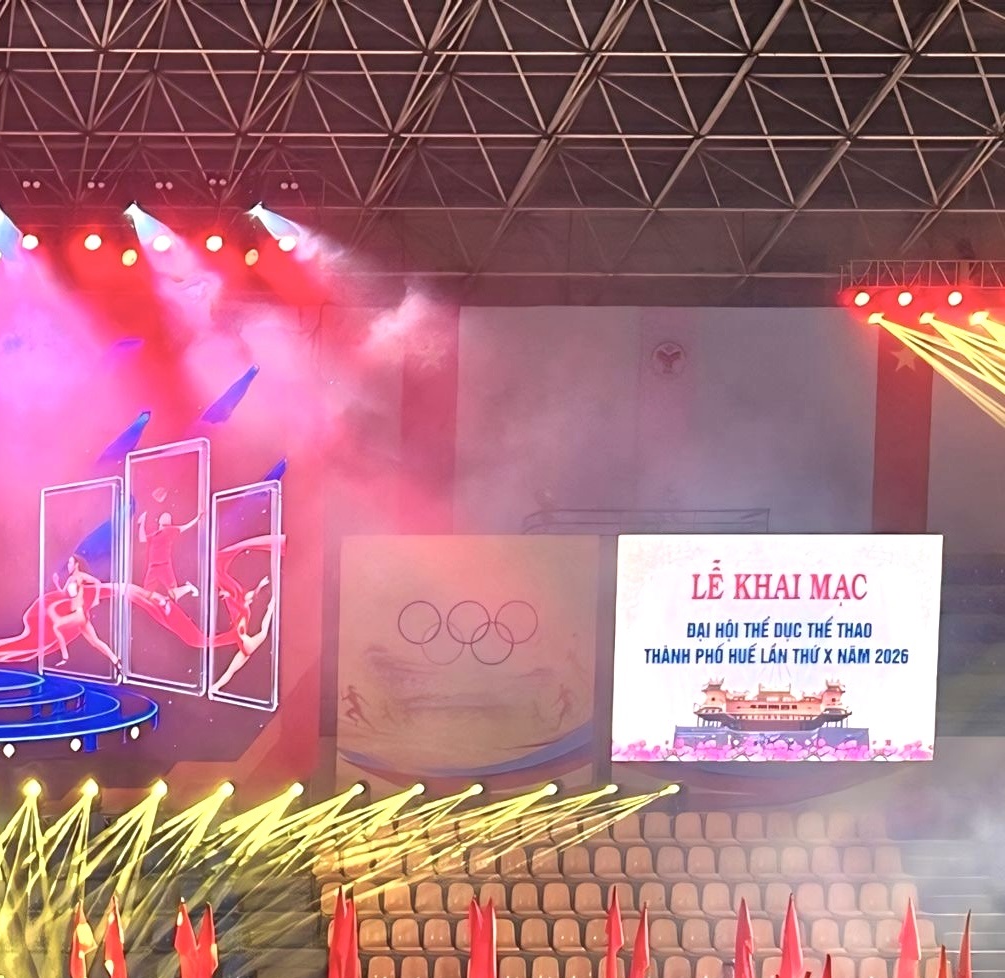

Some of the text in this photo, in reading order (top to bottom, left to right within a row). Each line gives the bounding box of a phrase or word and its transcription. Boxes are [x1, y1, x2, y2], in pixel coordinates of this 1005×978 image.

[691, 559, 867, 607] LỄ KHAI MẠC
[686, 622, 710, 642] ĐẠI
[715, 619, 738, 642] HỘI
[774, 622, 802, 642] DỤC
[836, 622, 872, 638] THAO
[729, 642, 757, 664] HUẾ
[824, 648, 833, 664] X
[875, 648, 909, 664] 2026
